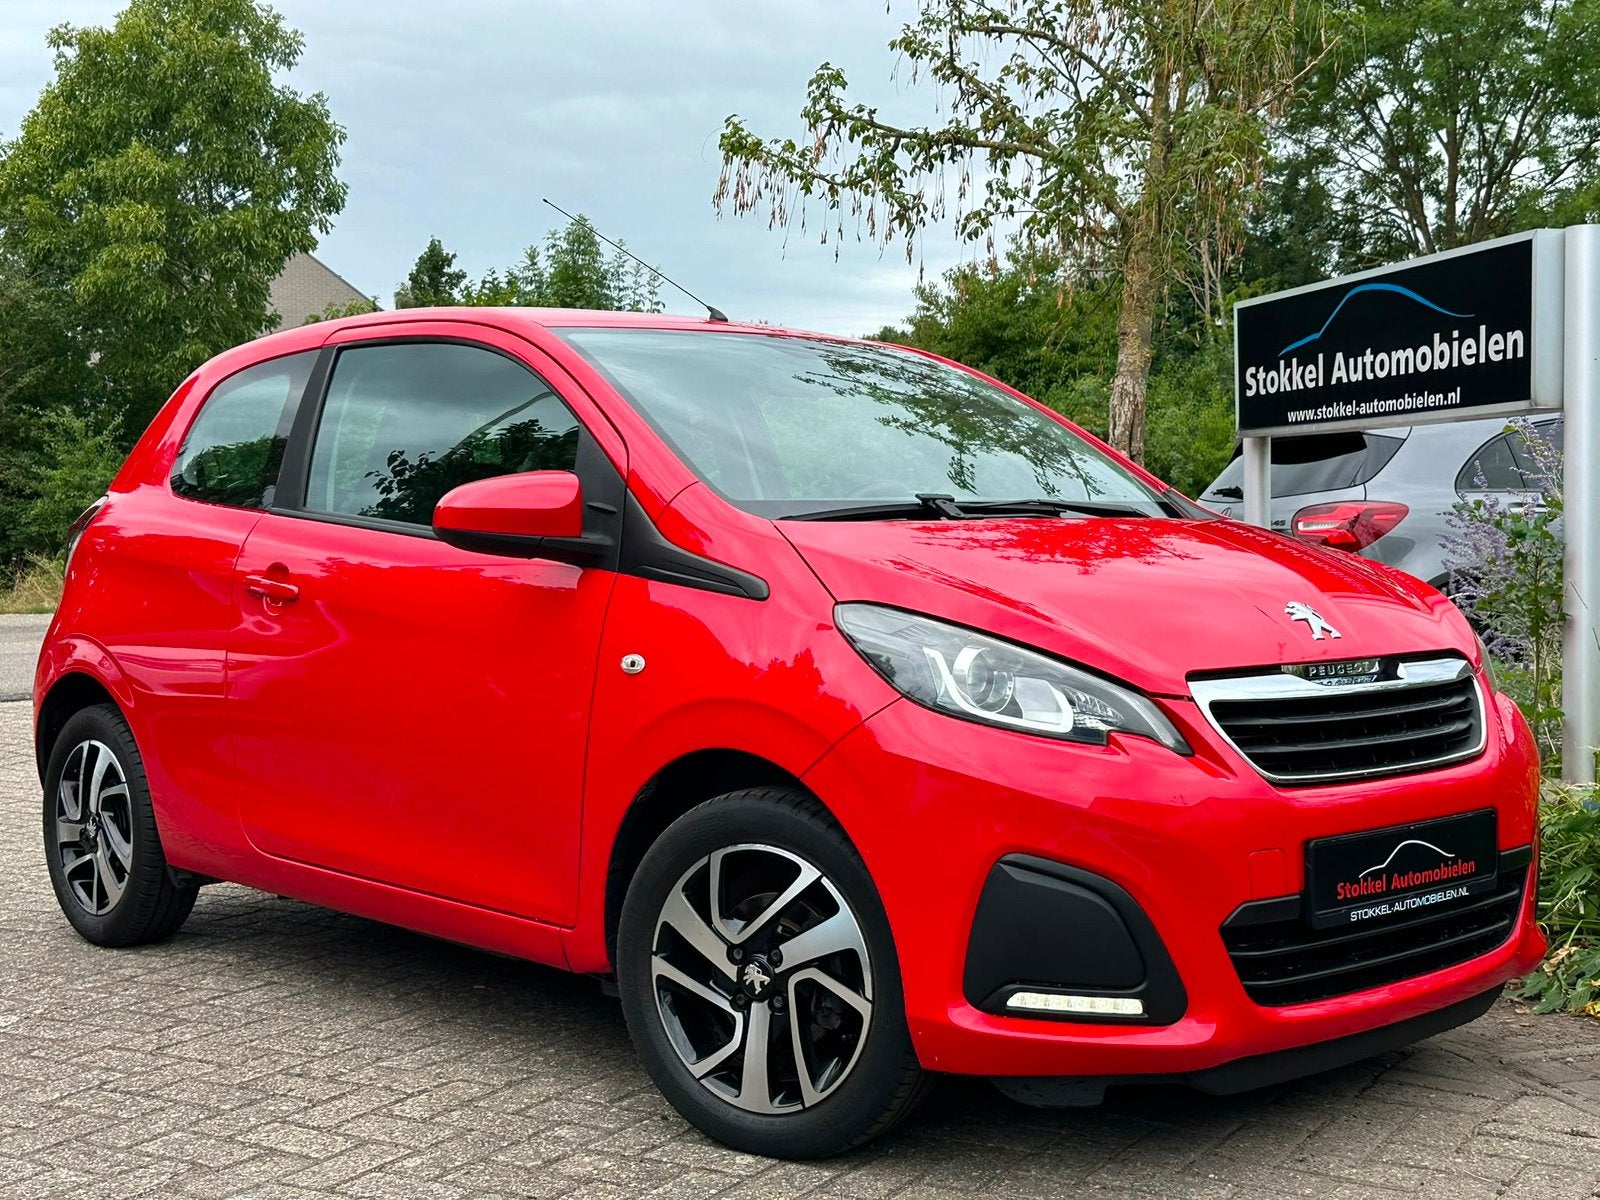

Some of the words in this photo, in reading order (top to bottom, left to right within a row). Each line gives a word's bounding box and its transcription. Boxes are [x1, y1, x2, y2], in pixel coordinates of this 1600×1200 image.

[1245, 352, 1324, 397] Stokkel
[1331, 324, 1524, 385] Automobielen
[1287, 387, 1461, 423] www.stokkel-automobielen.nl
[1308, 660, 1370, 677] PEUGEOT
[1337, 873, 1387, 900] Stokkel
[1391, 859, 1475, 890] Automobielen
[1350, 886, 1470, 922] STOKKEL-AUTOMOBIELEN.NL
